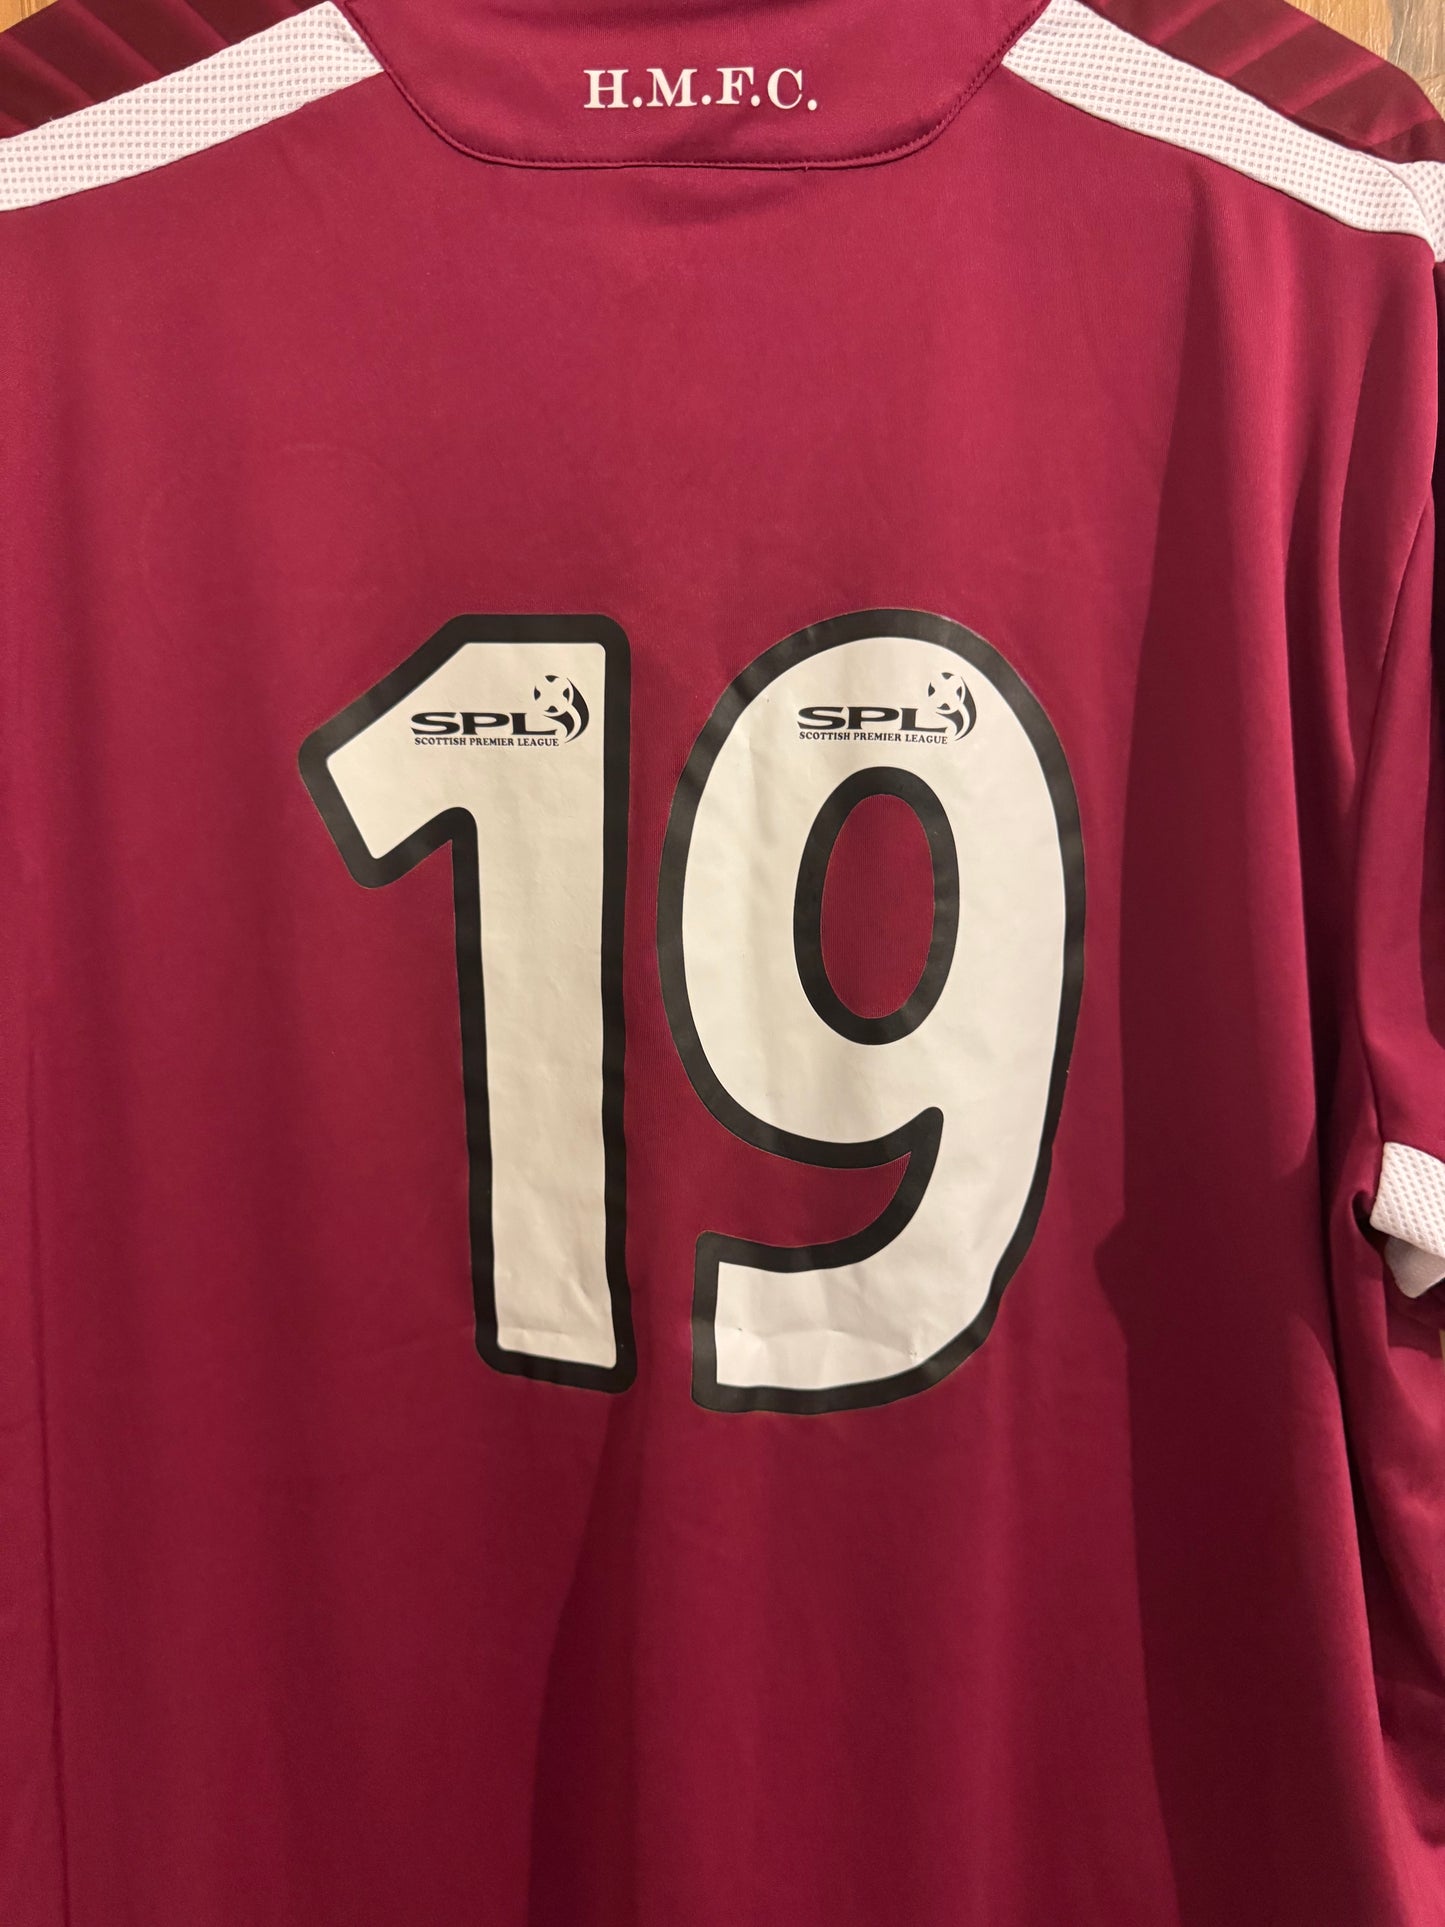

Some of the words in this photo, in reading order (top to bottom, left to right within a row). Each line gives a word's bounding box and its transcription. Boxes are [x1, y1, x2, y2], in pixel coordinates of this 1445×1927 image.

[583, 66, 818, 111] H.M.F.C.
[410, 712, 557, 735] SPL
[797, 706, 948, 733] SPL
[414, 737, 466, 746] SCOTTISH
[469, 737, 514, 746] PREMIER
[517, 738, 559, 747] LEAGUE
[799, 731, 850, 741] SCOTTISH
[854, 732, 901, 742] PREMIER
[905, 733, 948, 744] LEAGUE
[299, 607, 1087, 1413] 19
